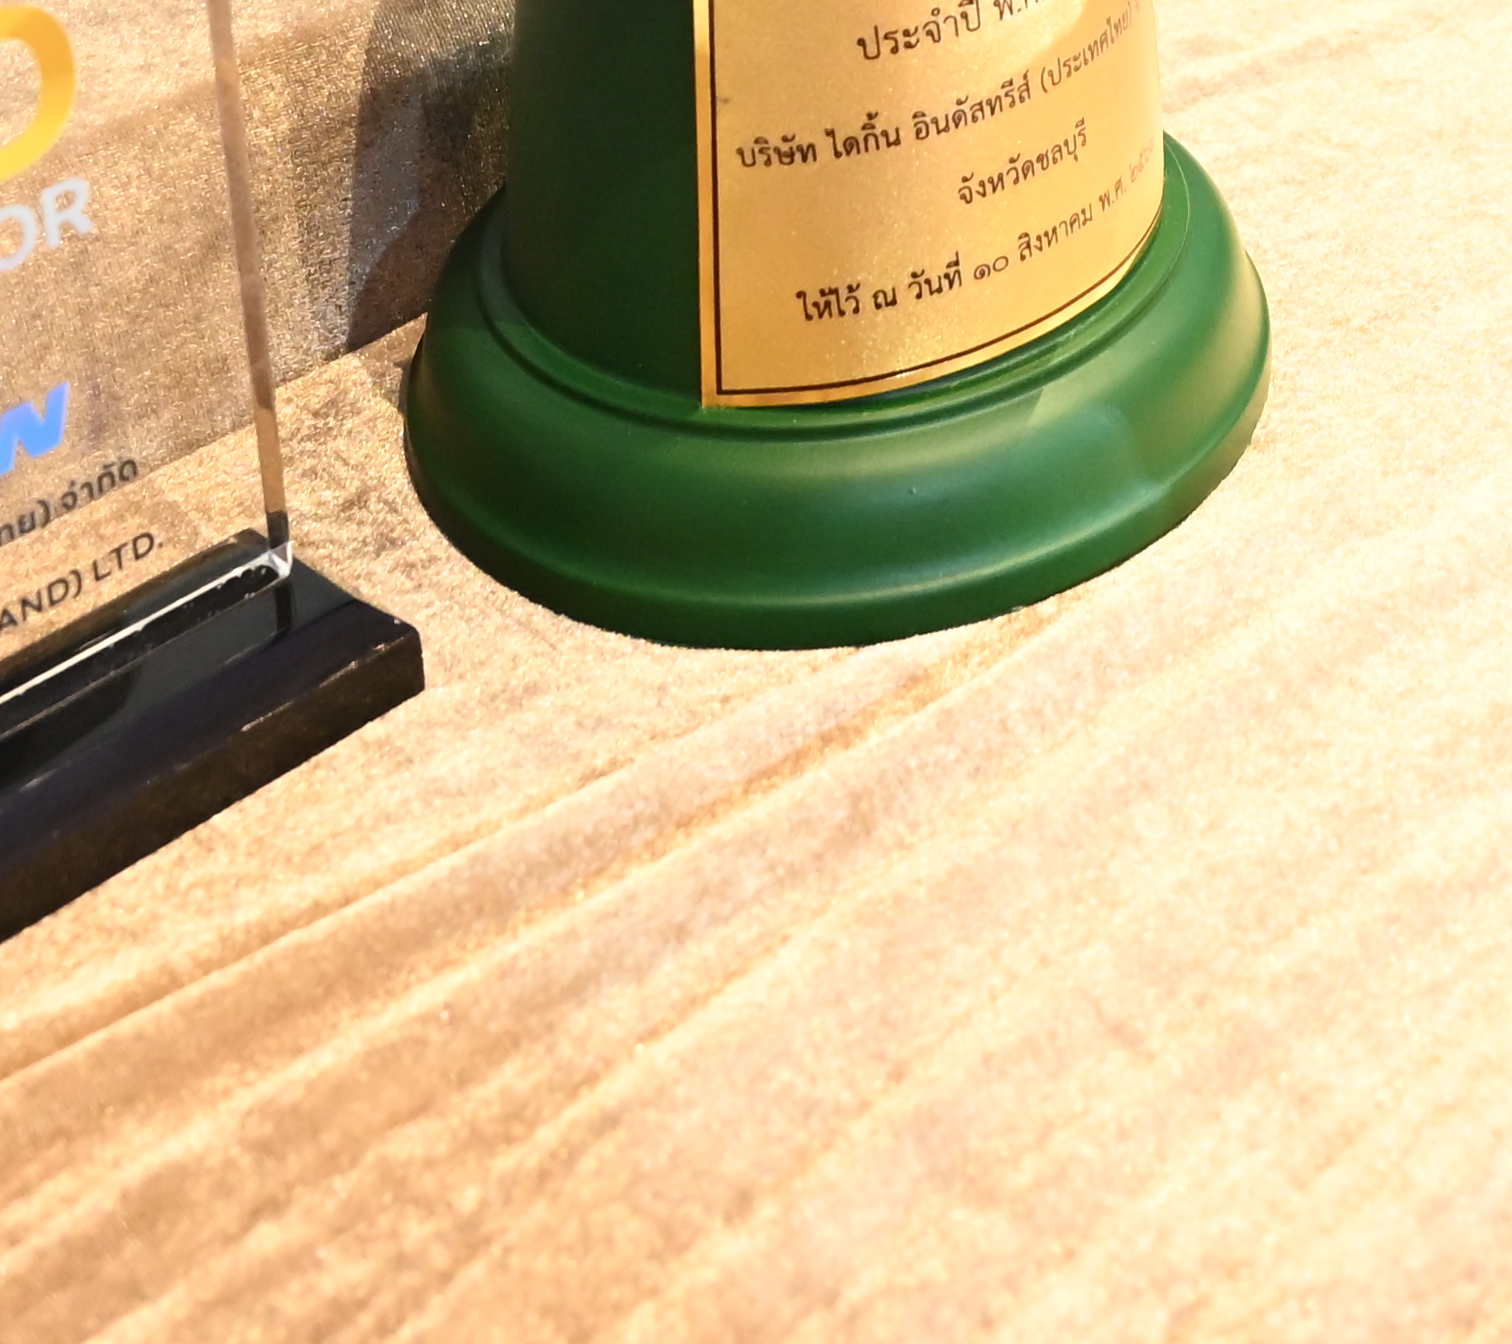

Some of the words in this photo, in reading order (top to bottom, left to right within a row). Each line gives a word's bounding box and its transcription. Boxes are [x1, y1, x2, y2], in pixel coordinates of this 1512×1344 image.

[736, 129, 818, 170] บริษัท
[824, 110, 903, 163] ไดกิ้น
[912, 69, 1033, 143] อินดัสทรีส์
[1040, 6, 1134, 95] (ประเทศไทย)
[957, 116, 1090, 207] จังหวัดชลบุรี
[796, 281, 864, 324] ให้ไว้
[873, 285, 899, 312] ณ
[907, 249, 963, 305] วันที่
[973, 254, 1011, 283] ๑๐
[1016, 204, 1094, 264] สิงหาคม
[61, 456, 139, 514] จำกัด
[92, 530, 164, 583] LTD.
